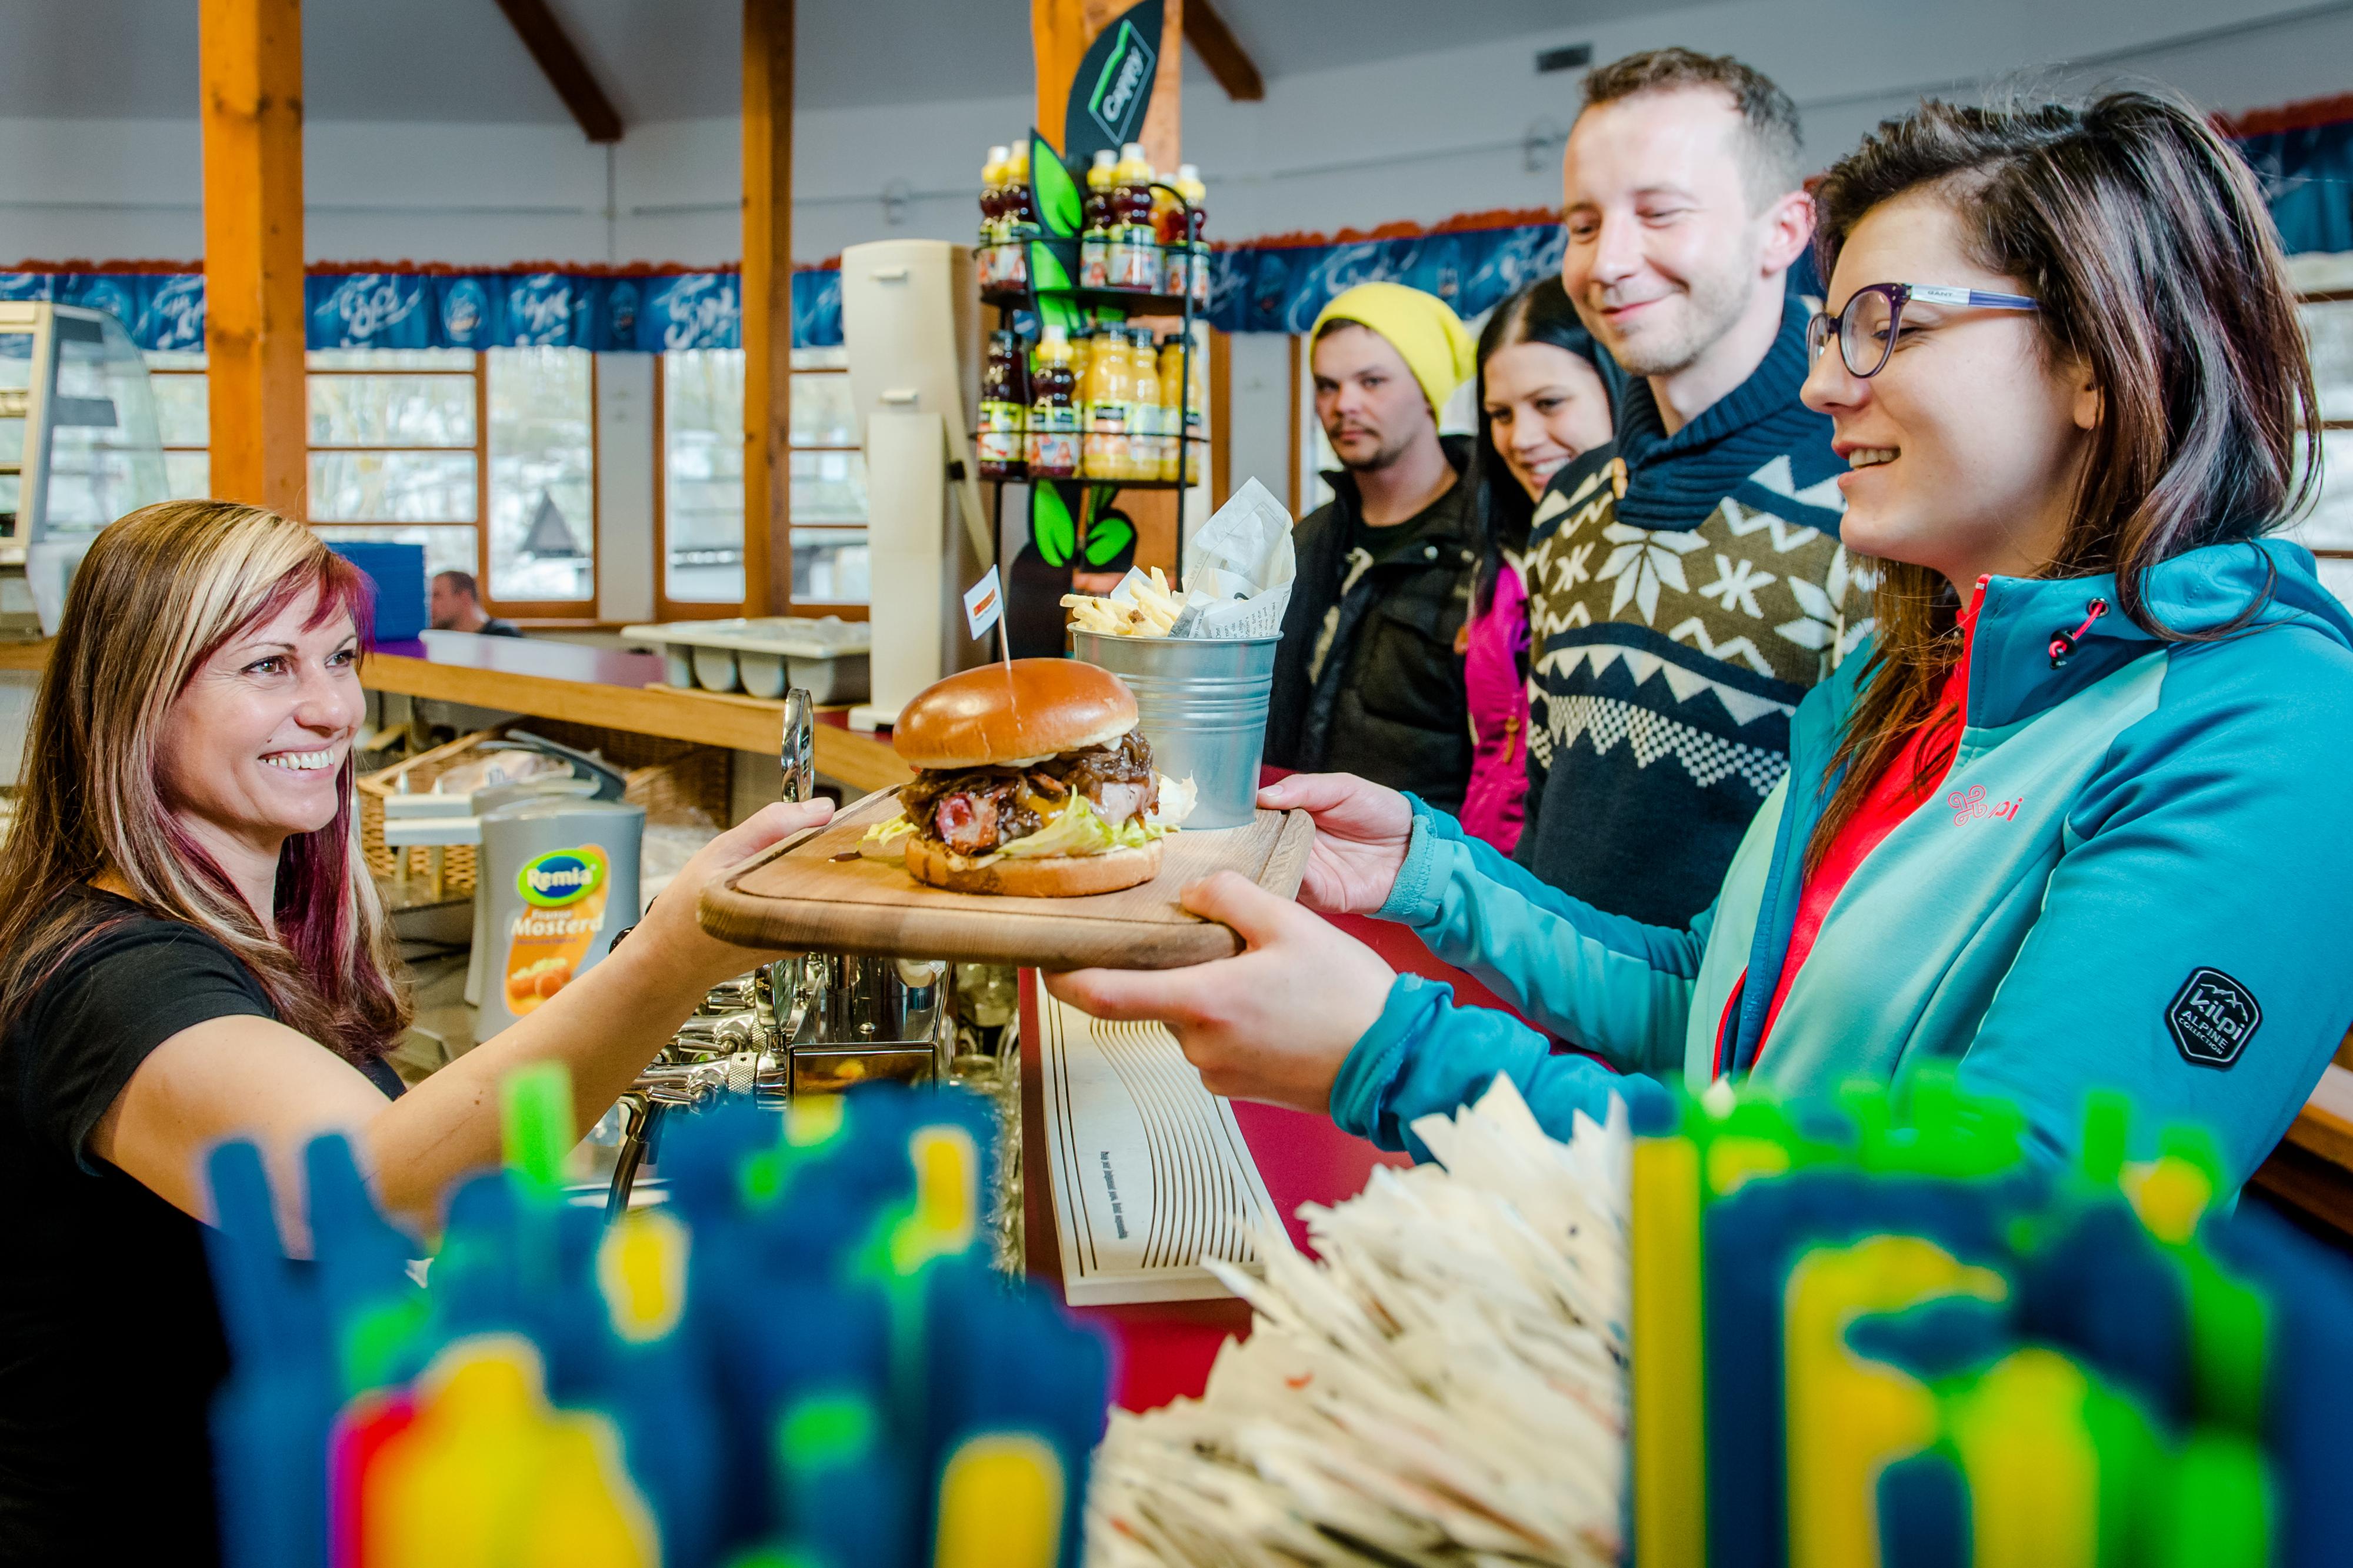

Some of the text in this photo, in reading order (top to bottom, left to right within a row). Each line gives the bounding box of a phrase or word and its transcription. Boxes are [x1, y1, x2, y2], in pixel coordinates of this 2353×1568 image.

[526, 866, 593, 892] Remia
[511, 913, 604, 936] Mosterd
[2179, 1018, 2222, 1055] COLLECTION
[2181, 1010, 2228, 1049] ALPINE
